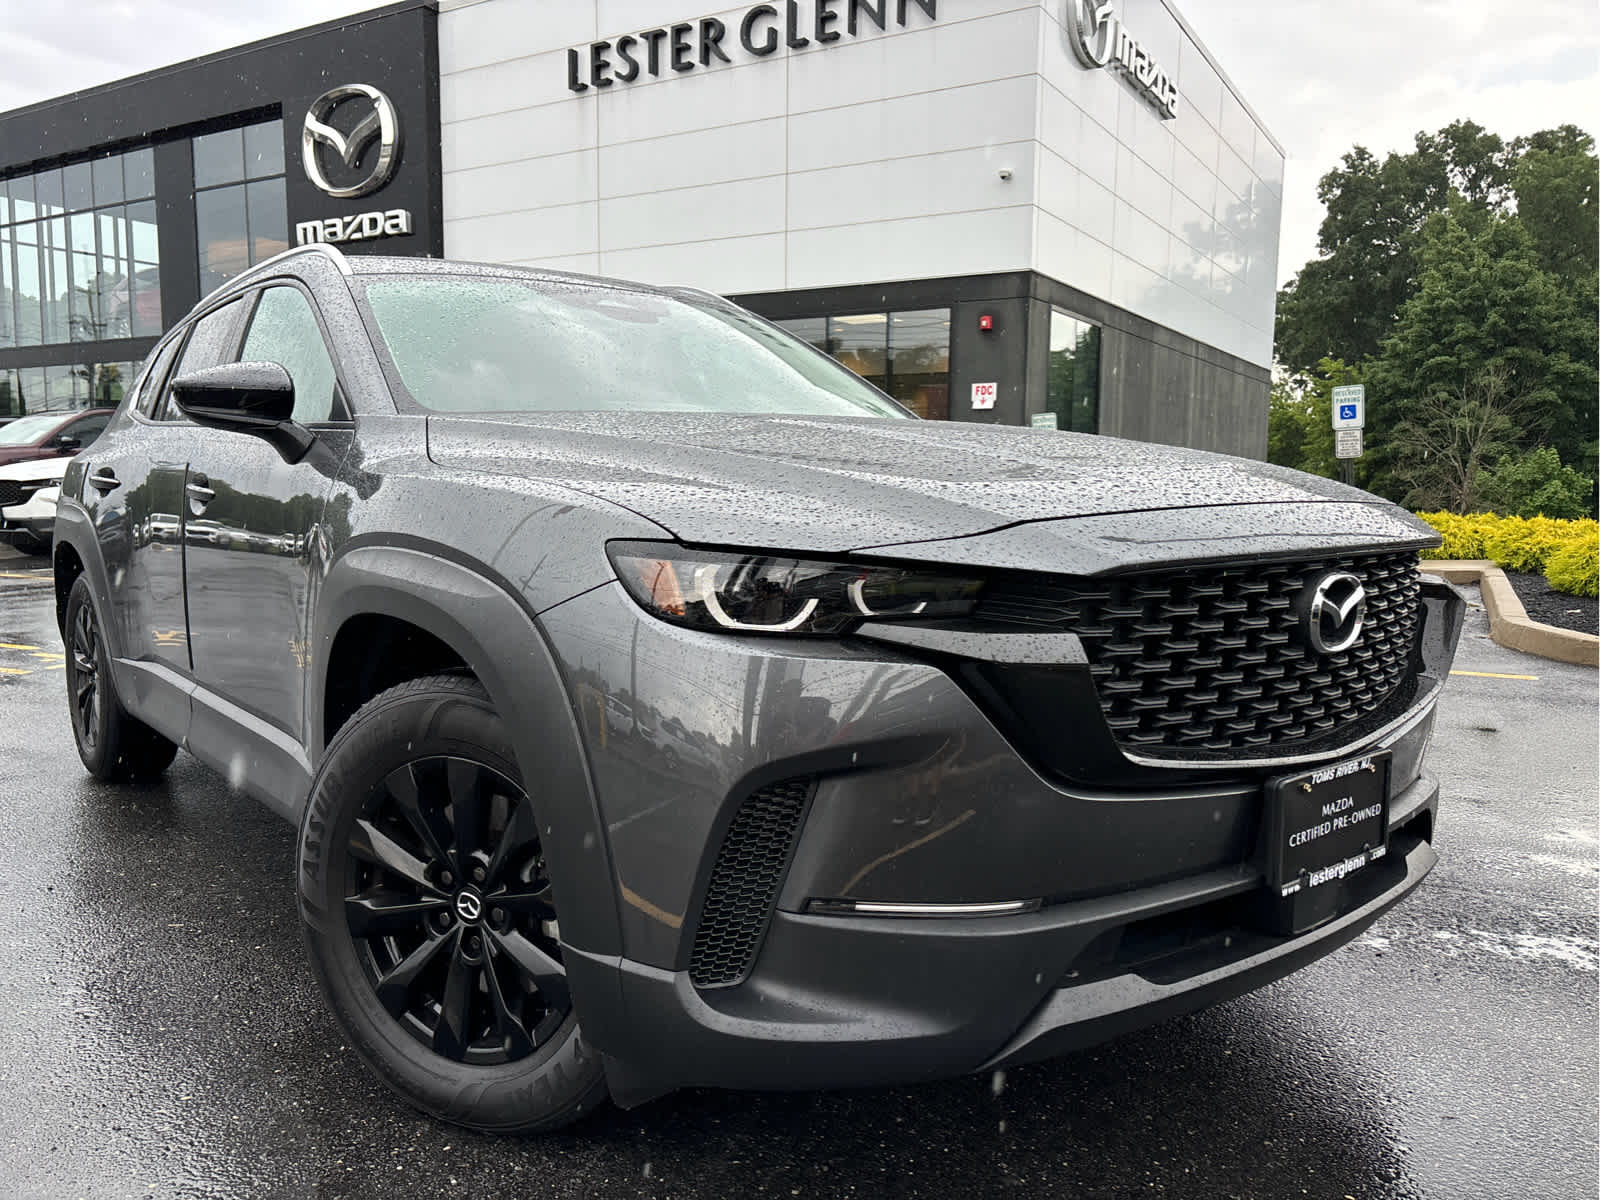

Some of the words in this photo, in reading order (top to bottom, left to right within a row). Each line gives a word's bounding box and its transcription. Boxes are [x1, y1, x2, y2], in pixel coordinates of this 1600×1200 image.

[567, 17, 732, 92] LESTER
[740, 0, 936, 57] GLENN
[295, 208, 412, 246] mazda
[975, 385, 993, 396] FDC
[1311, 768, 1336, 785] TOMS
[1321, 796, 1354, 817] MAZDA
[1289, 822, 1331, 847] CERTIFIED
[1333, 803, 1382, 831] PRE-OWNED
[1309, 856, 1365, 887] lesterglenn
